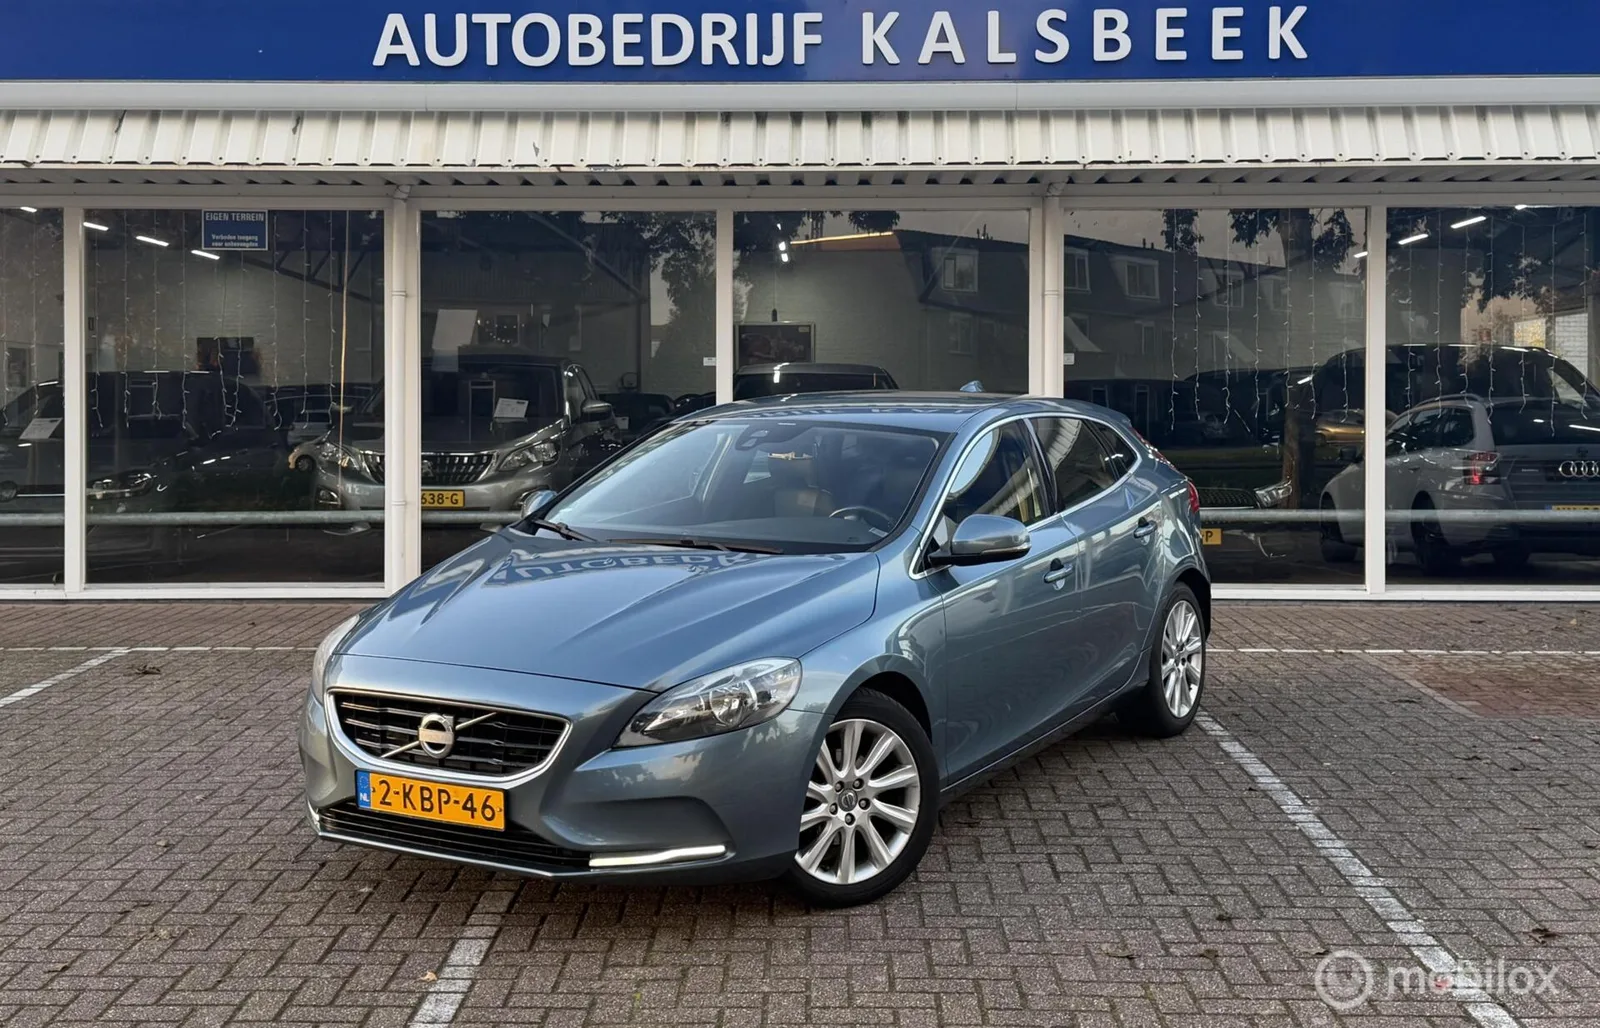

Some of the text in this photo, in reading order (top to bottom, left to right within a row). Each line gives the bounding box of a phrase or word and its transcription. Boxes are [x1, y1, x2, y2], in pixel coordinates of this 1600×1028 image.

[372, 5, 1308, 67] AUTOBEDRIJF KALSBEEK
[206, 212, 264, 221] EIGEN TERREIN
[421, 492, 459, 505] 638-G
[359, 779, 497, 822] NL 2-KBP-46
